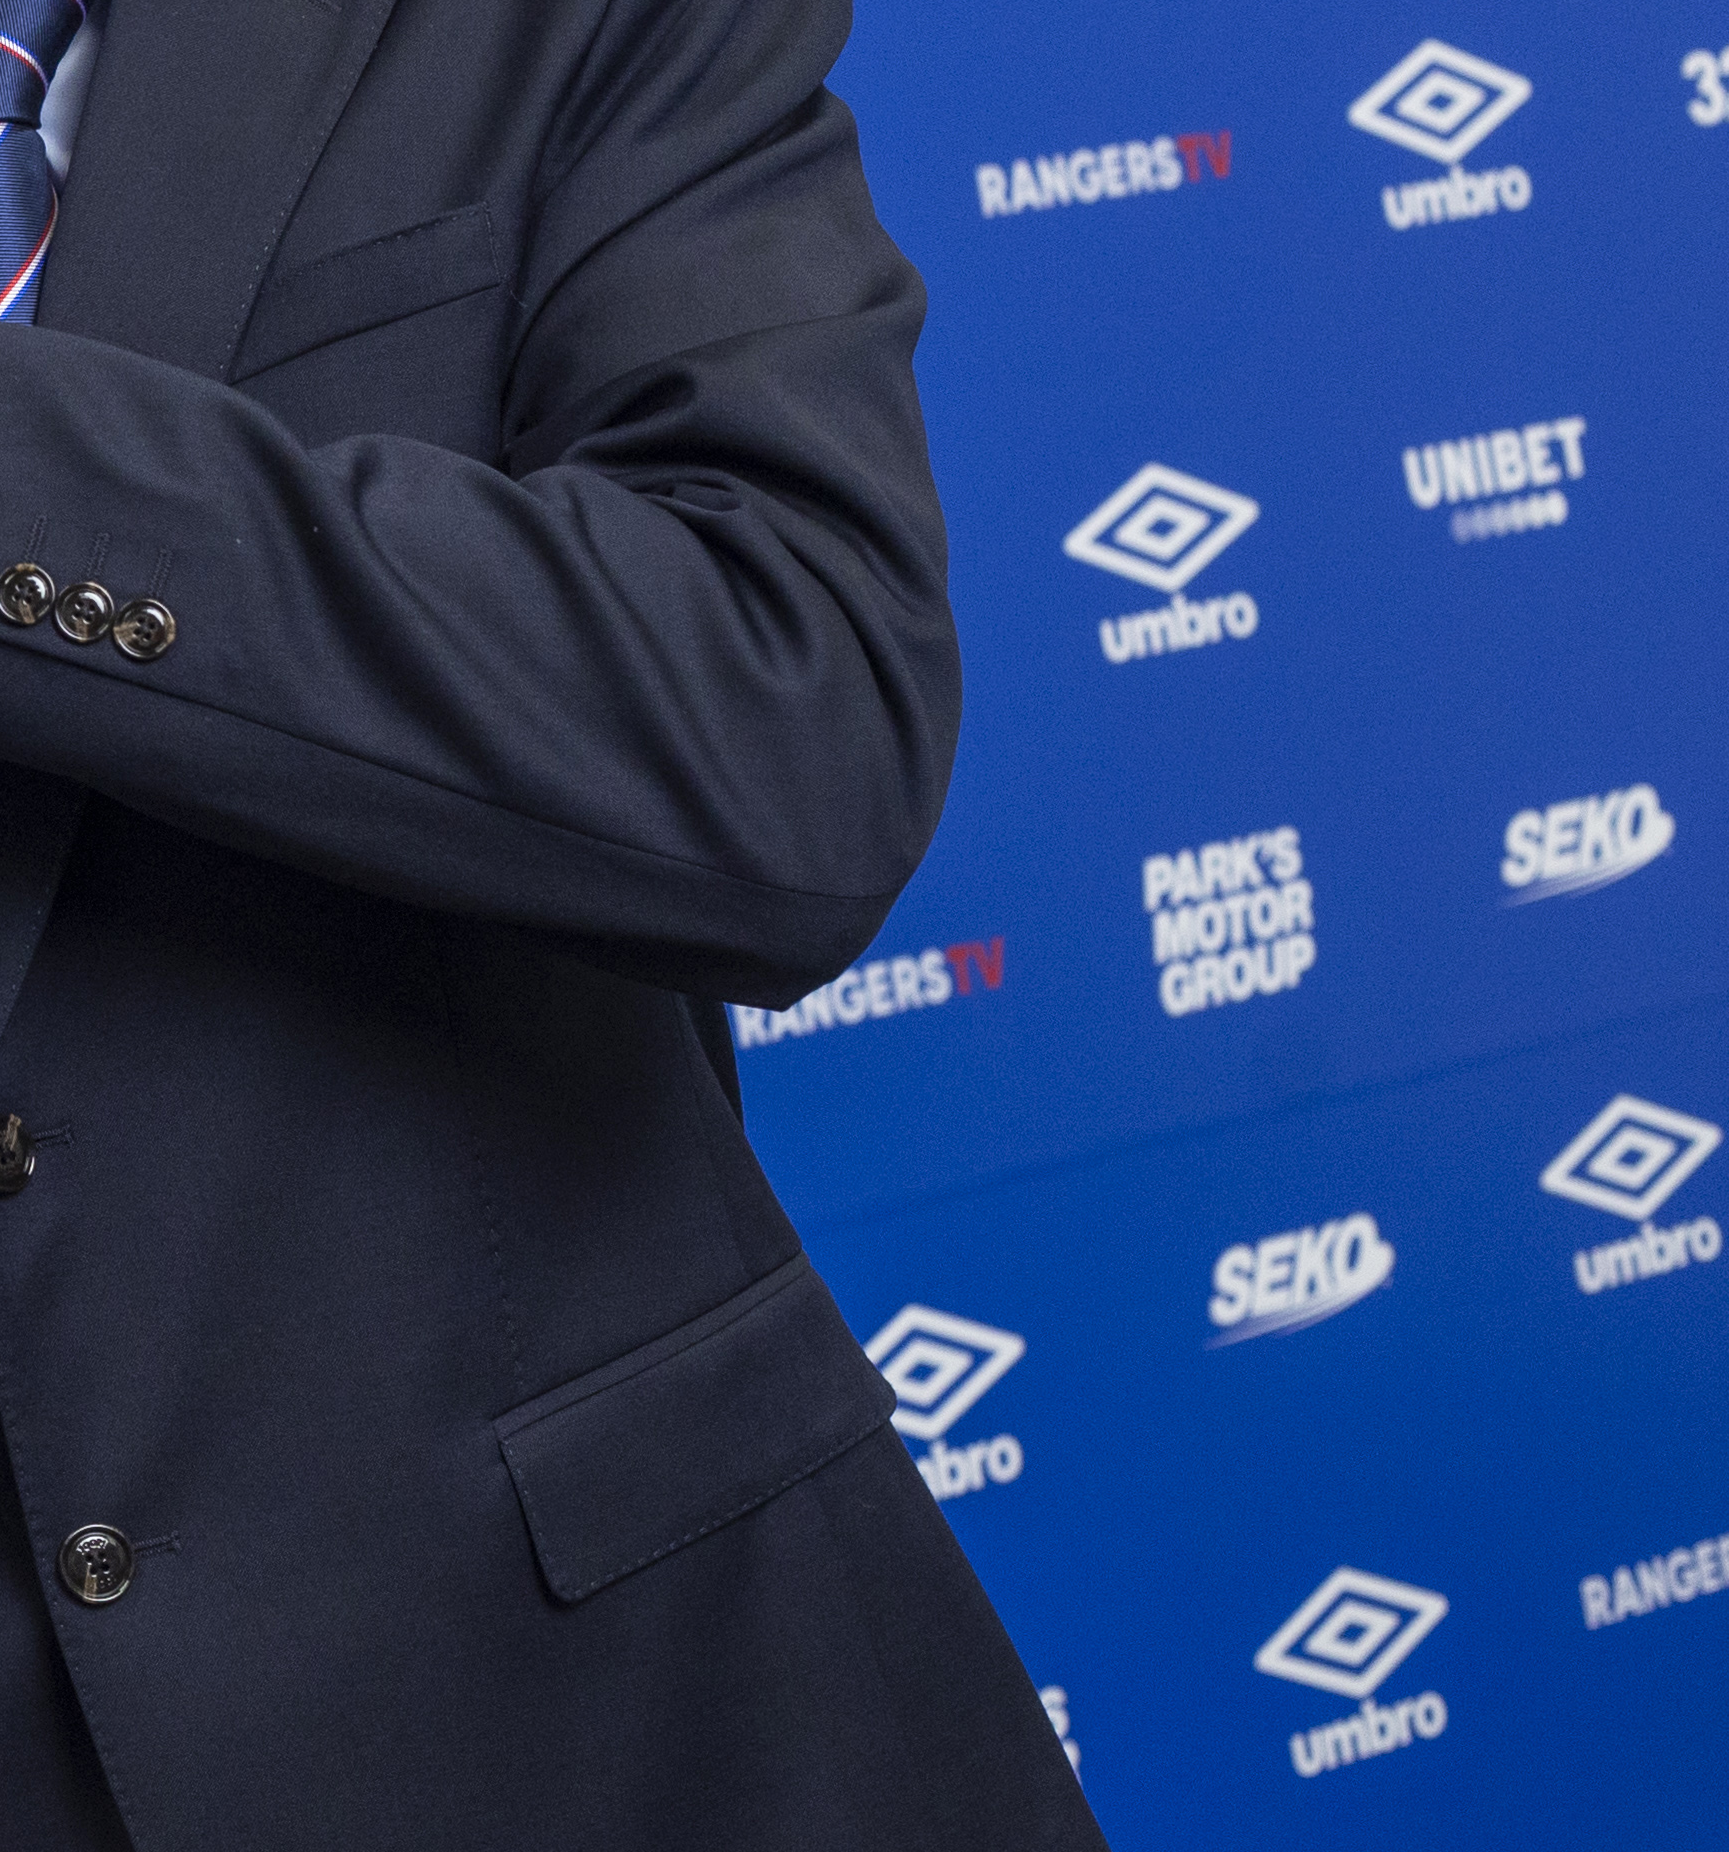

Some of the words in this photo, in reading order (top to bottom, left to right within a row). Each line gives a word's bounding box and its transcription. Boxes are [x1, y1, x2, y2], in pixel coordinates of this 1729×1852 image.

[1382, 163, 1532, 231] umbro
[1403, 416, 1586, 511] UNIBET
[1099, 592, 1259, 663] umbro
[1501, 784, 1675, 886] SEKO
[1153, 879, 1314, 966] MOTOR
[1160, 934, 1316, 1017] GROUP
[1209, 1213, 1395, 1327] SEKO
[1574, 1213, 1723, 1294] umbro
[1580, 1533, 1729, 1630] RANGE
[1290, 1687, 1448, 1777] umbro
